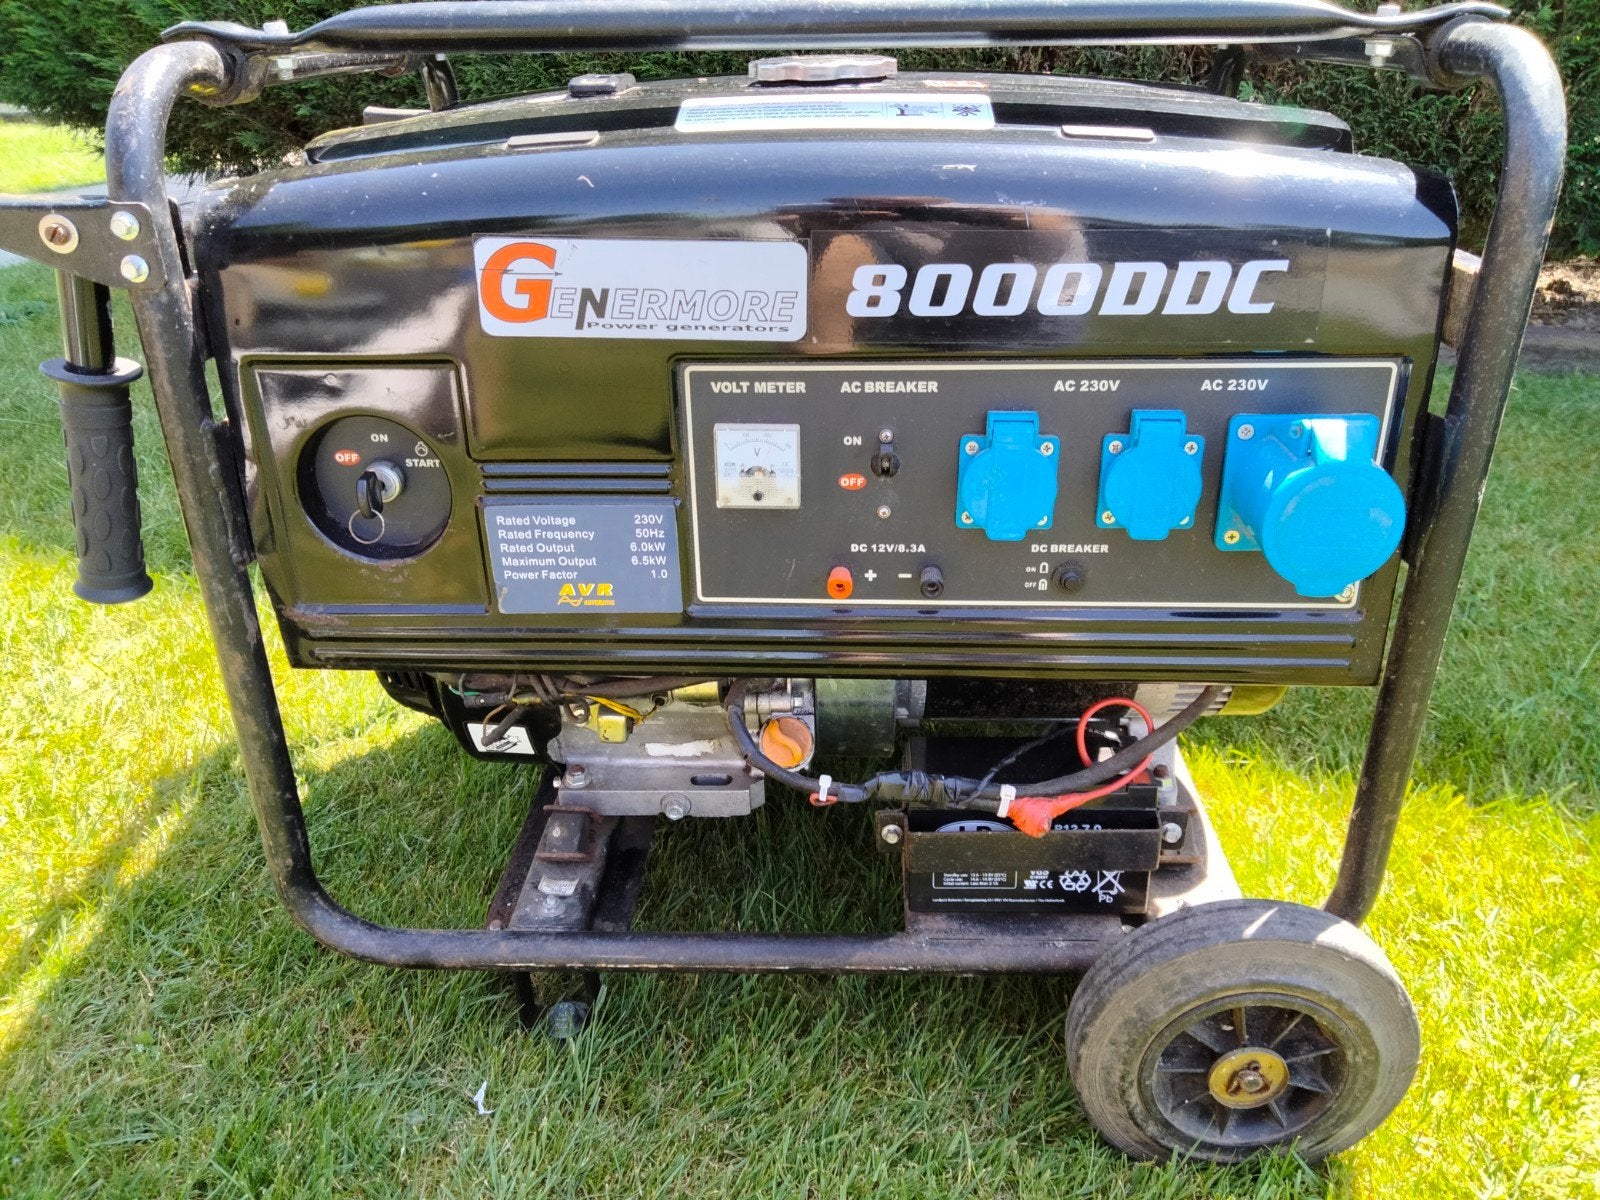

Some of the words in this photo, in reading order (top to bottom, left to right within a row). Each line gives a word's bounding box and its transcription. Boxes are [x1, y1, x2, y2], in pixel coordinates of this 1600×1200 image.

[480, 242, 798, 330] GENERMORE
[845, 260, 1290, 318] 8000DDC
[587, 321, 659, 330] Power
[666, 323, 789, 333] generators
[711, 382, 749, 393] VOLT
[754, 382, 806, 393] METER
[841, 382, 861, 393] AC
[864, 382, 938, 393] BREAKER
[1054, 380, 1075, 392] AC
[1080, 380, 1120, 392] 230V
[1201, 379, 1223, 391] AC
[1227, 379, 1268, 391] 230V
[370, 434, 388, 442] ON
[843, 436, 861, 445] ON
[335, 453, 359, 462] OFF
[754, 448, 760, 456] V
[405, 459, 440, 467] START
[840, 478, 864, 487] OFF
[496, 516, 530, 525] Rated
[532, 516, 576, 527] Voltage
[634, 515, 663, 524] 230V
[498, 530, 532, 539] Rated
[535, 530, 595, 541] Frequency
[635, 528, 665, 538] 50Hz
[500, 543, 533, 552] Rated
[536, 543, 575, 554] Output
[630, 542, 666, 552] 6.0kW
[851, 544, 867, 552] DC
[871, 544, 926, 553] 12V/8.3A
[1031, 544, 1048, 553] DC
[1051, 544, 1108, 553] BREAKER
[502, 557, 556, 566] Maximum
[559, 556, 597, 567] Output
[631, 556, 667, 565] 6.5kW
[504, 570, 539, 579] Power
[542, 570, 578, 579] Factor
[651, 569, 667, 578] 1.0
[559, 583, 613, 596] AVR
[1099, 895, 1113, 903] Pb
